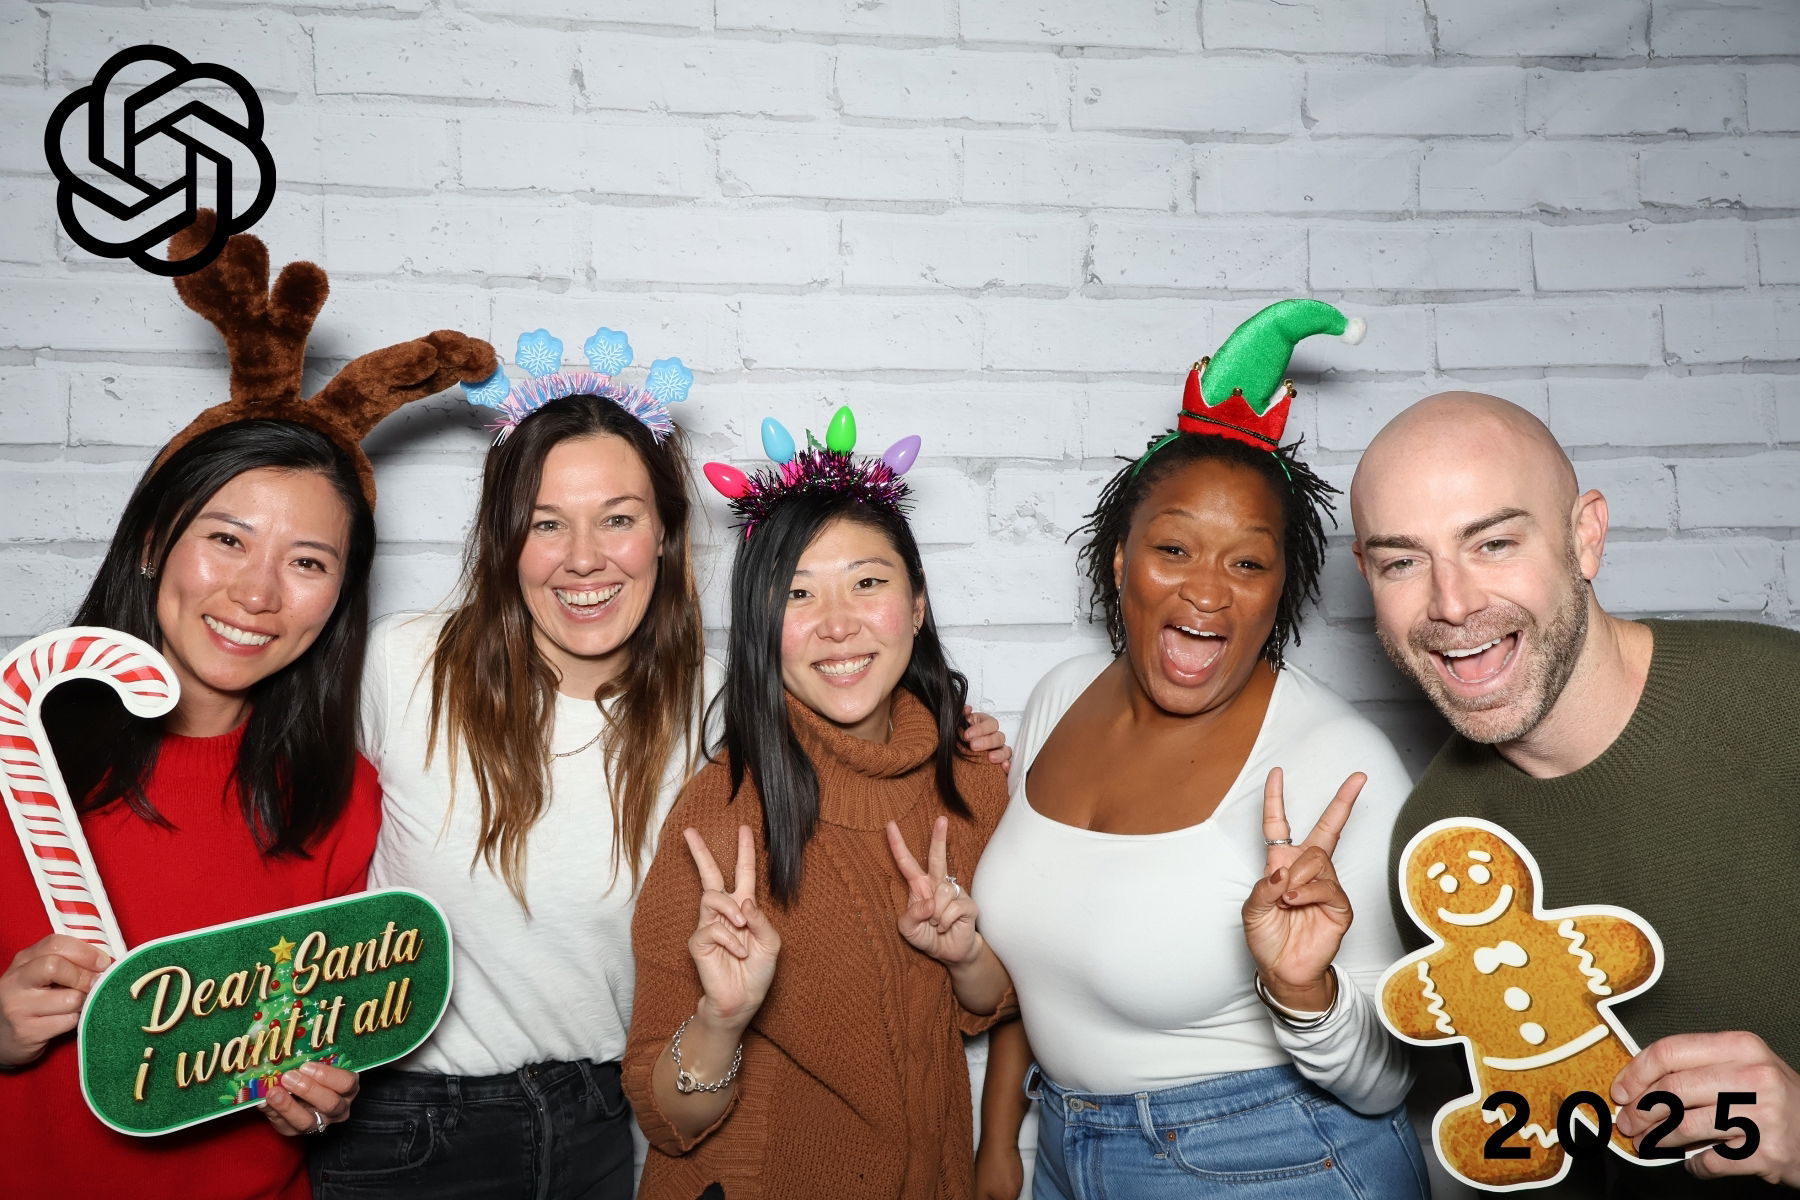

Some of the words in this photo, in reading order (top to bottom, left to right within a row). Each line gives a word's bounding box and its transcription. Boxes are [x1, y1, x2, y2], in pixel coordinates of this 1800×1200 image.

[130, 961, 271, 1033] Dear
[292, 921, 423, 995] Santa
[133, 1046, 154, 1102] i
[176, 1006, 304, 1088] want
[311, 995, 346, 1050] it
[353, 977, 413, 1035] all
